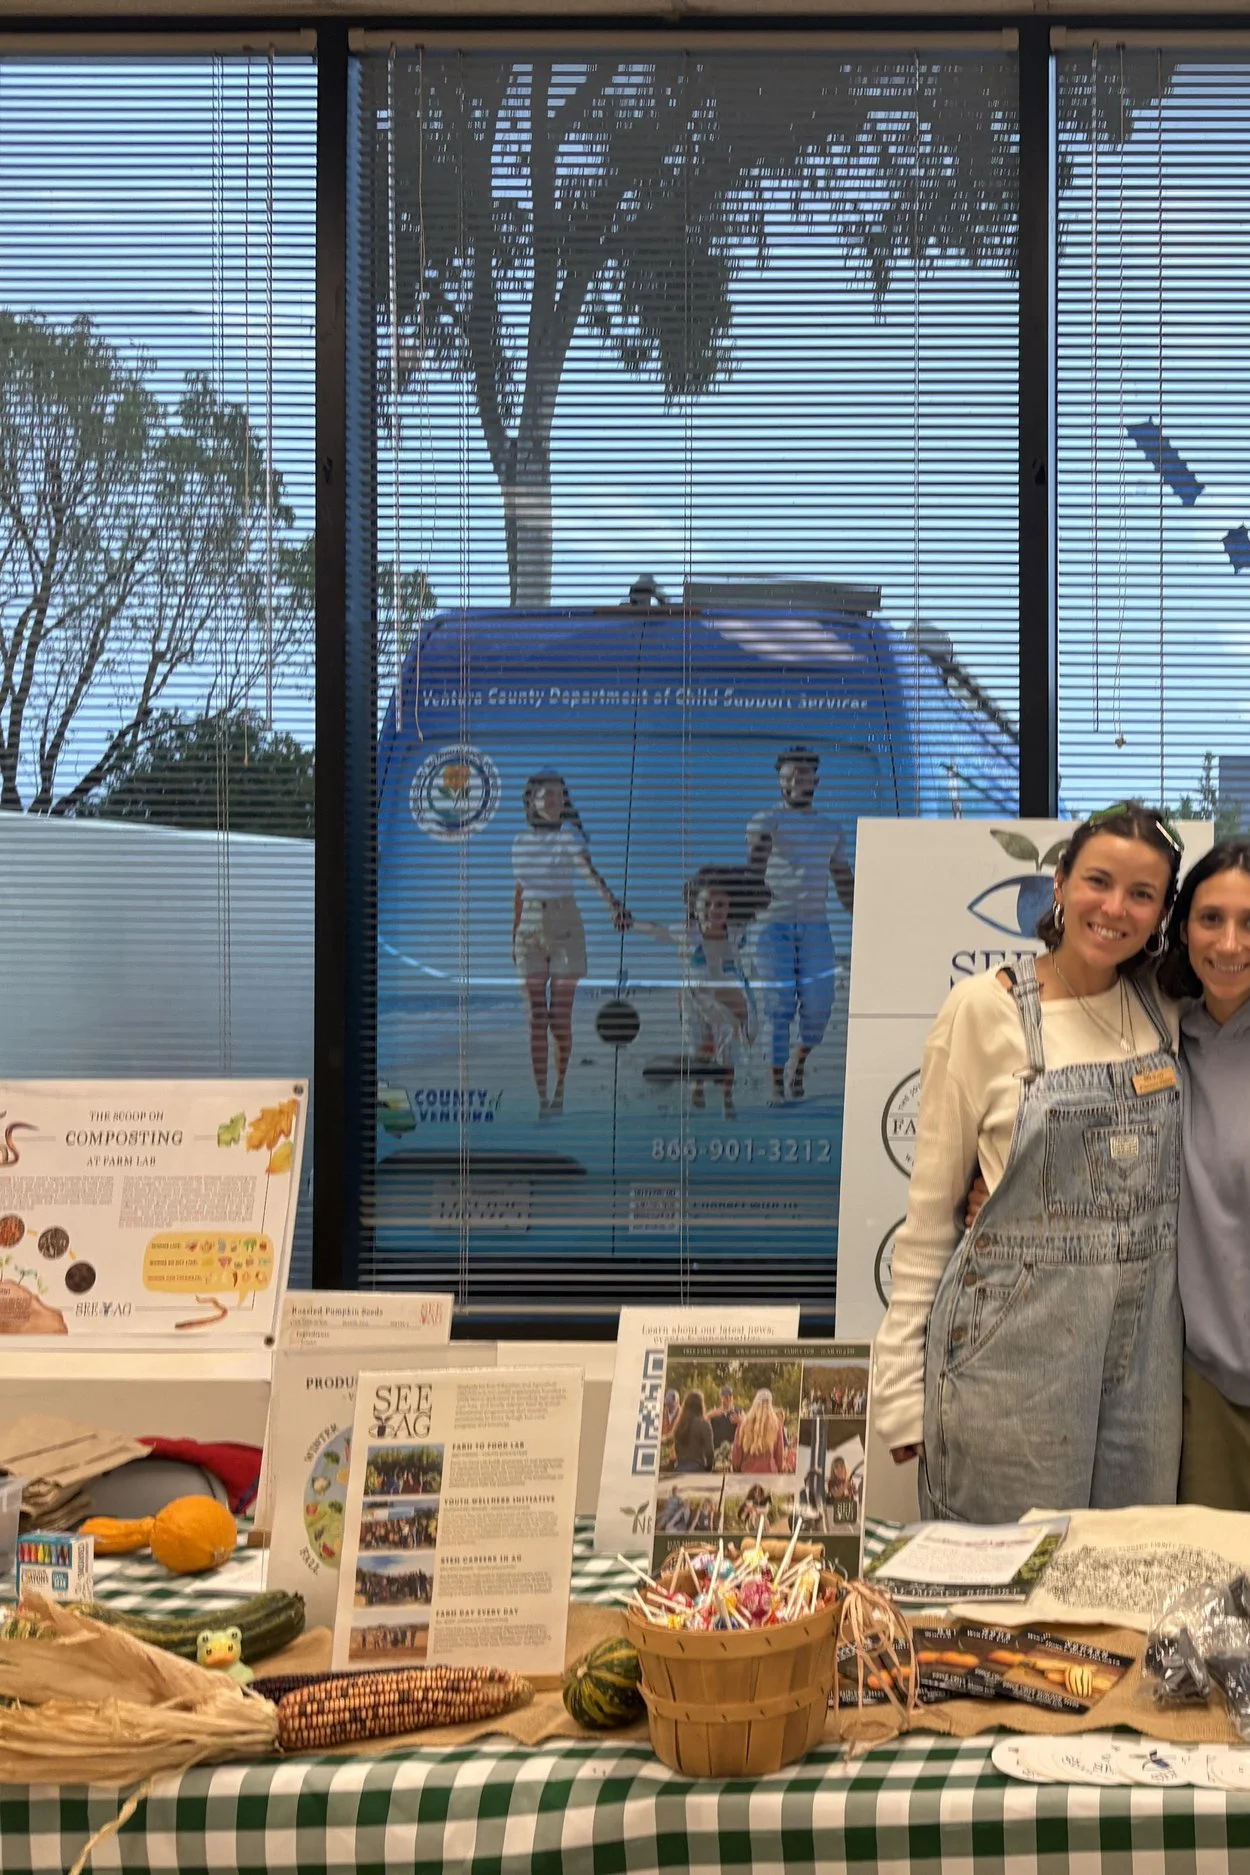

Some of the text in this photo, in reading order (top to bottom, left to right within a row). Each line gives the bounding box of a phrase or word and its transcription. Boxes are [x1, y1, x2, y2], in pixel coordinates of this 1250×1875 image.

[422, 689, 483, 707] Ventura
[488, 687, 545, 708] County
[550, 687, 649, 708] Department
[654, 688, 671, 706] of
[675, 688, 719, 707] Child
[415, 1088, 488, 1107] COUNTY
[90, 1110, 110, 1122] THE
[149, 1110, 164, 1122] ON
[65, 1129, 183, 1147] COMPOSTING
[87, 1155, 156, 1167] AT FARM LAB
[292, 1304, 383, 1318] Roasted Pumpkin Seeds
[642, 1325, 668, 1336] Learn
[671, 1325, 698, 1336] about
[306, 1375, 358, 1391] PRODU
[373, 1383, 433, 1415] SEE
[393, 1411, 432, 1439] AG
